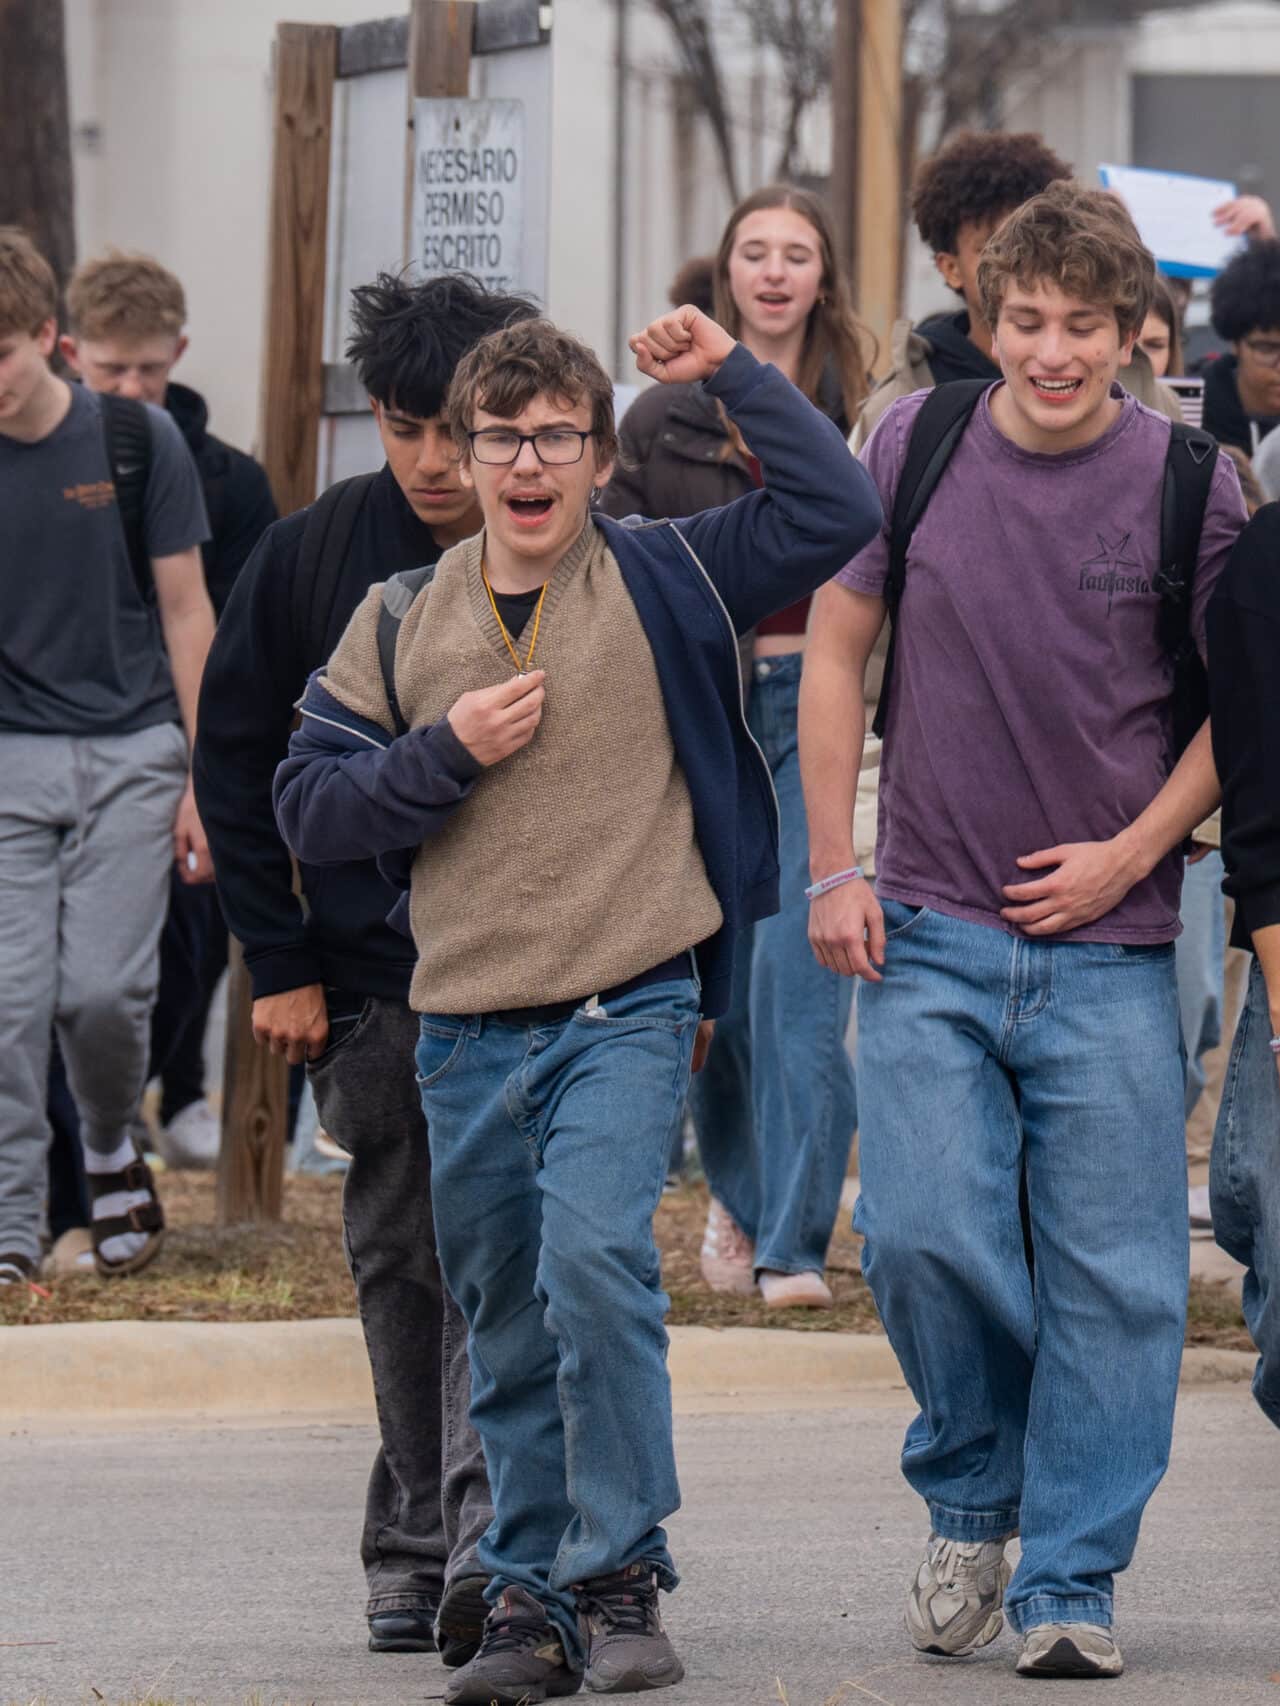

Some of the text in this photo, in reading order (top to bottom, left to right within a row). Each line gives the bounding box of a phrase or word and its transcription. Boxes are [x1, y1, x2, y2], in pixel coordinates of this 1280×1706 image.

[420, 149, 517, 184] NECESARIO
[424, 191, 505, 228] PERMISO
[423, 234, 502, 271] ESCRITO
